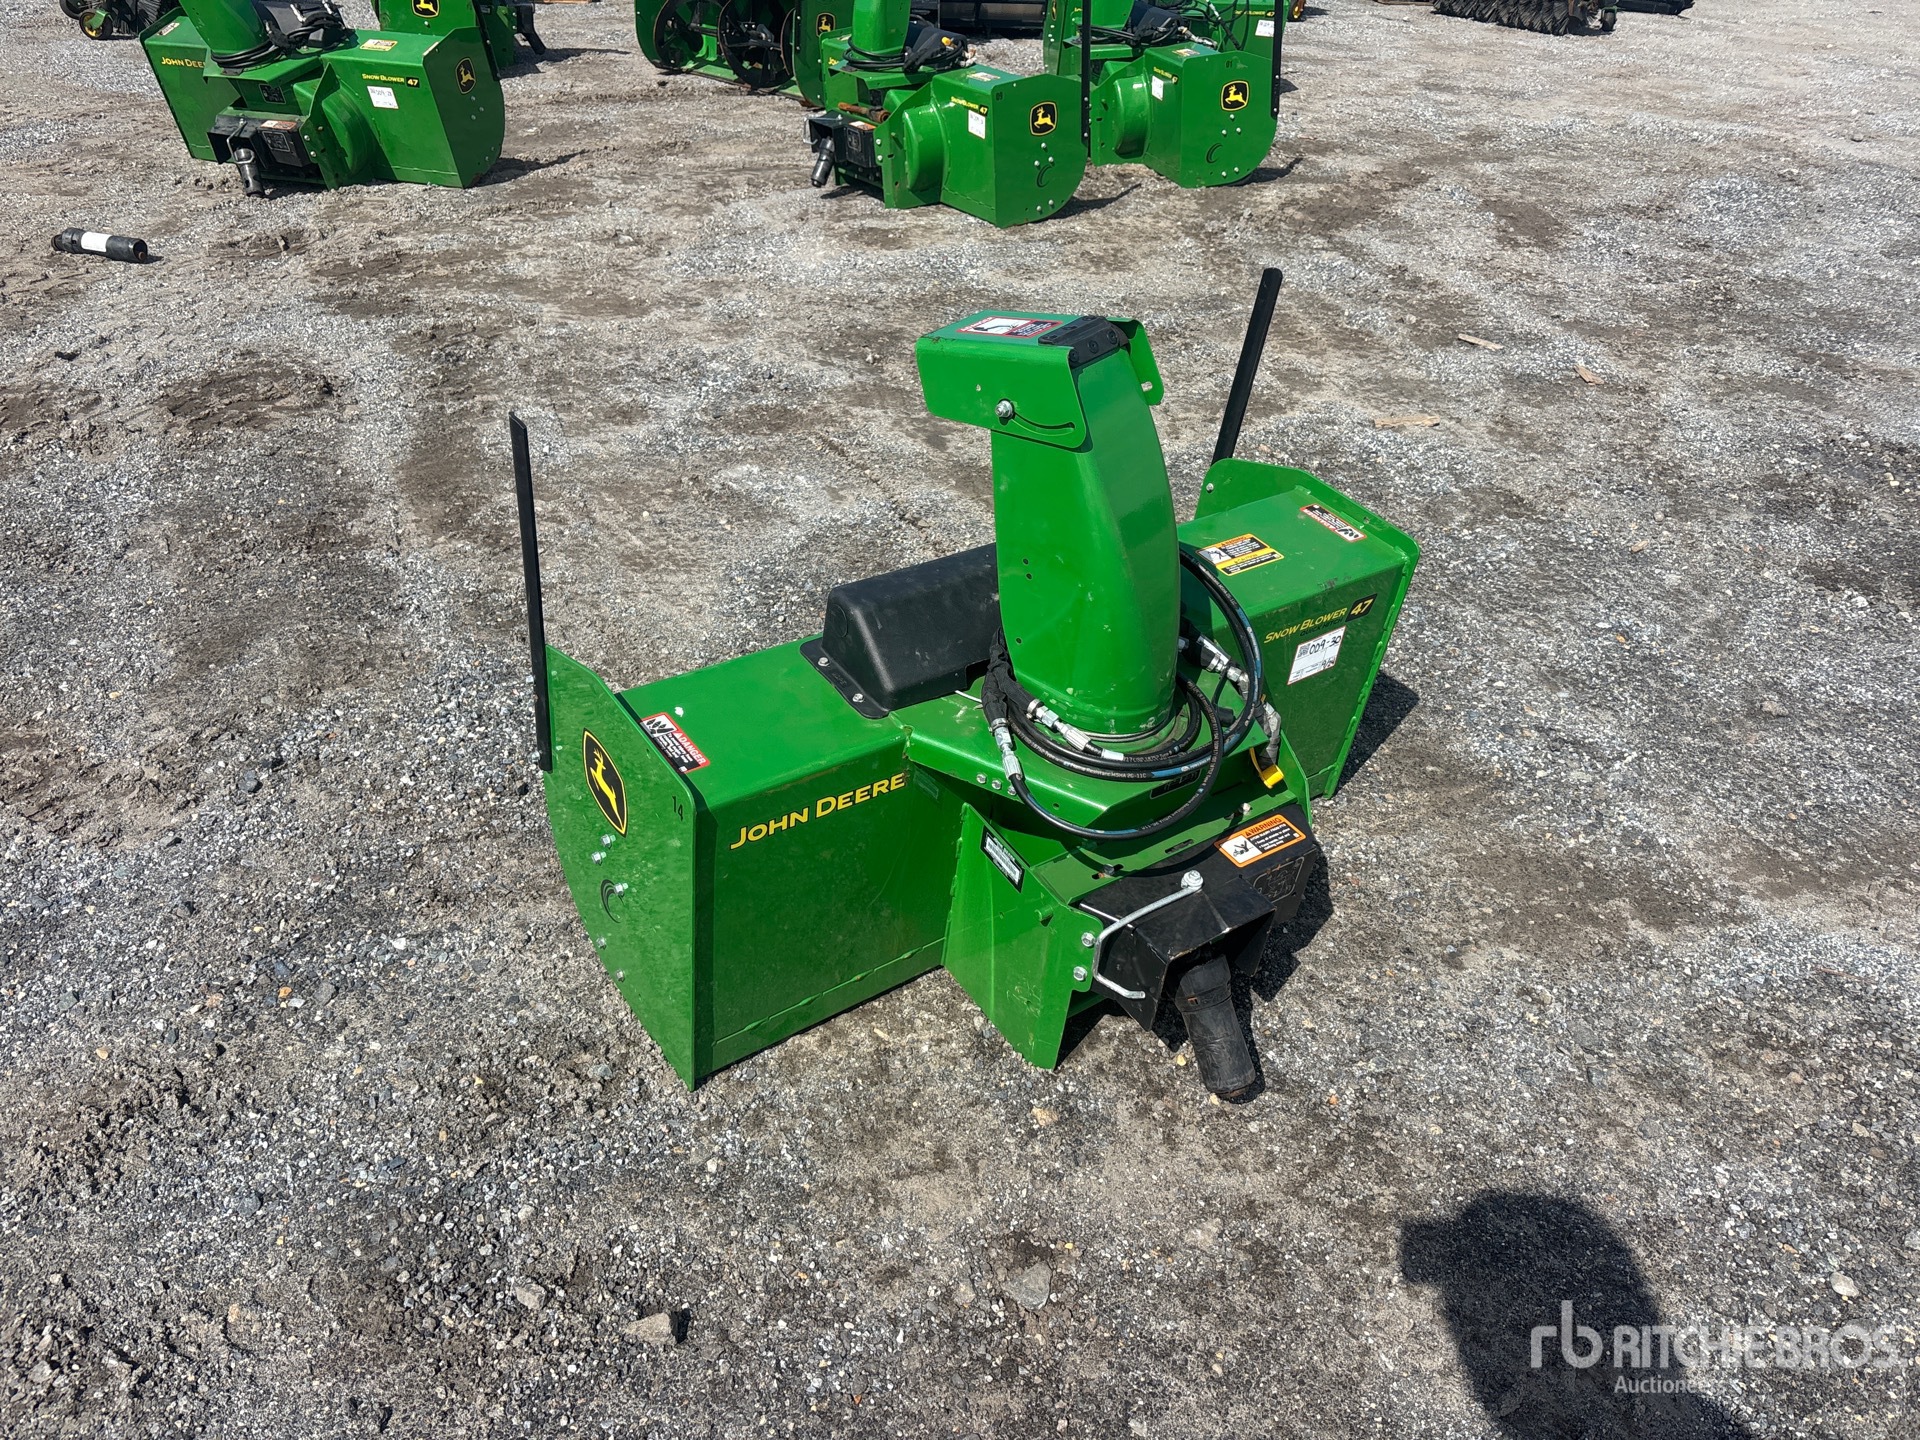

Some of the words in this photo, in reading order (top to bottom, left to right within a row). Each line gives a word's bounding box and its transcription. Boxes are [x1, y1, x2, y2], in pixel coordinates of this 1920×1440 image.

[161, 56, 184, 66] JOHN
[185, 58, 206, 69] DEE
[380, 75, 405, 83] BLOWER
[1263, 623, 1300, 644] SNOW
[1300, 607, 1348, 630] BLOWER
[1350, 598, 1374, 616] 47
[678, 736, 707, 764] DANGER
[671, 795, 684, 822] 14
[730, 807, 809, 850] JOHN
[815, 772, 906, 818] DEERE
[1249, 817, 1281, 834] WARNING
